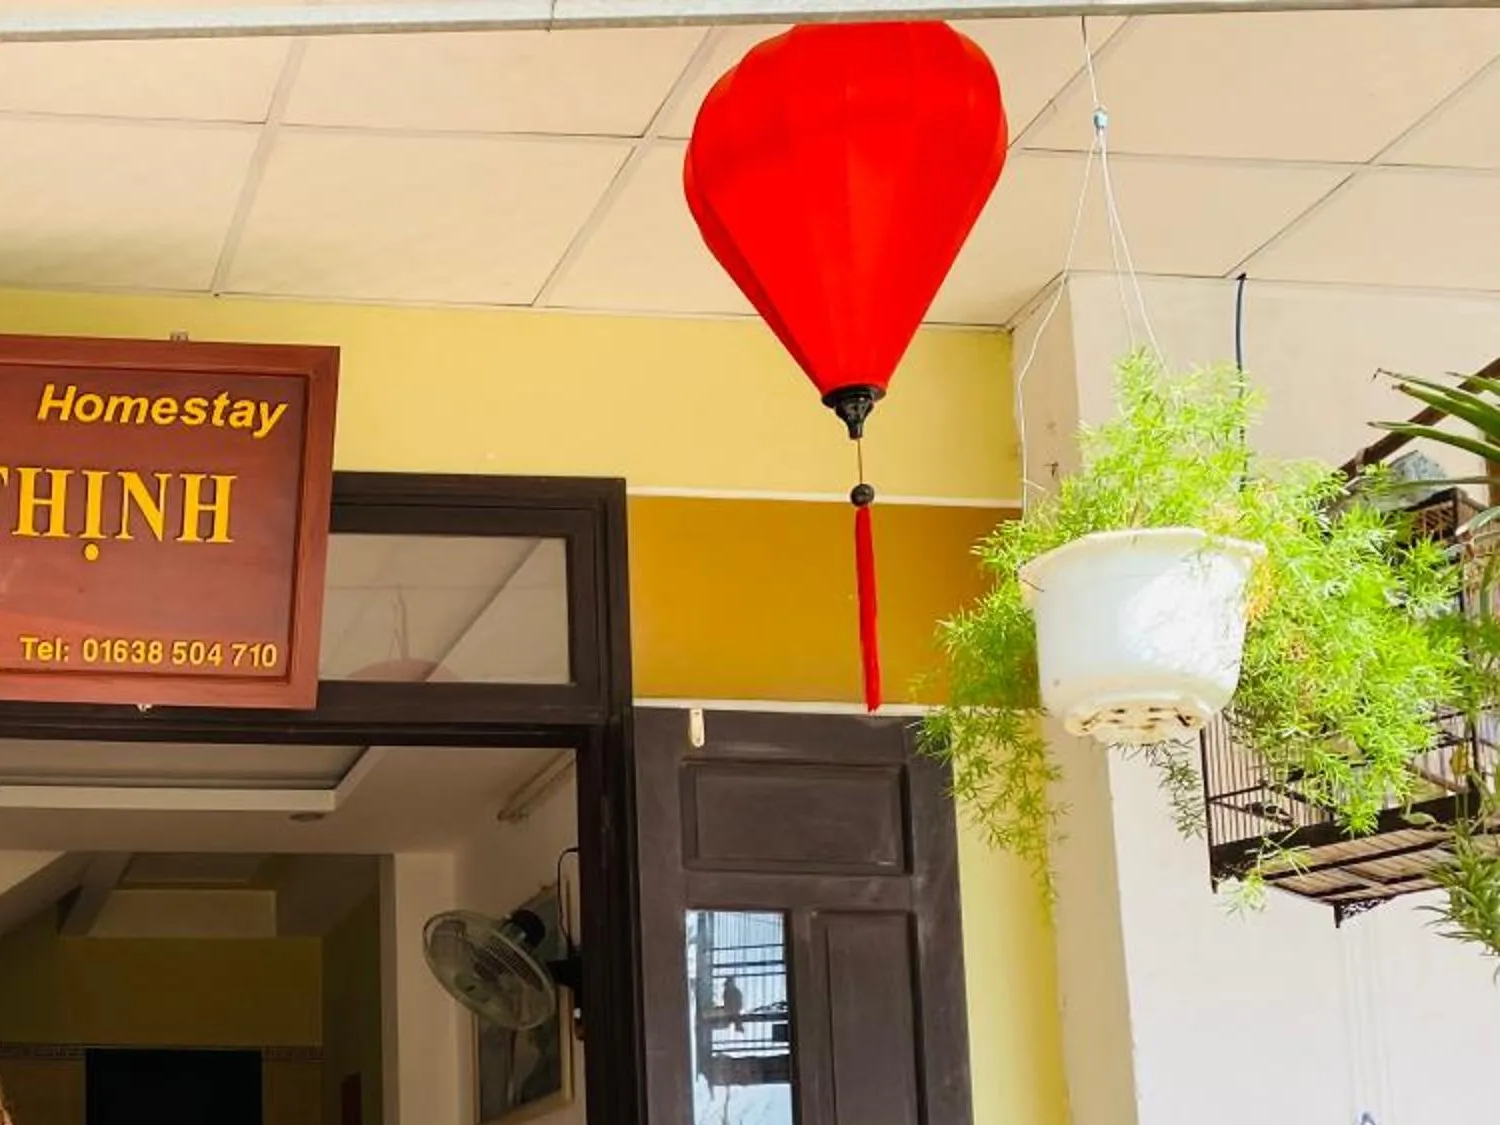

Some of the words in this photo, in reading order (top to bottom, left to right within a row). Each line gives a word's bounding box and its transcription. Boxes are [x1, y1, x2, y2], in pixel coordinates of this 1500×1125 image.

[37, 384, 287, 438] Homestay
[19, 636, 71, 663] Tel:
[82, 637, 164, 666] 01638
[171, 640, 224, 668] 504
[231, 643, 278, 668] 710
